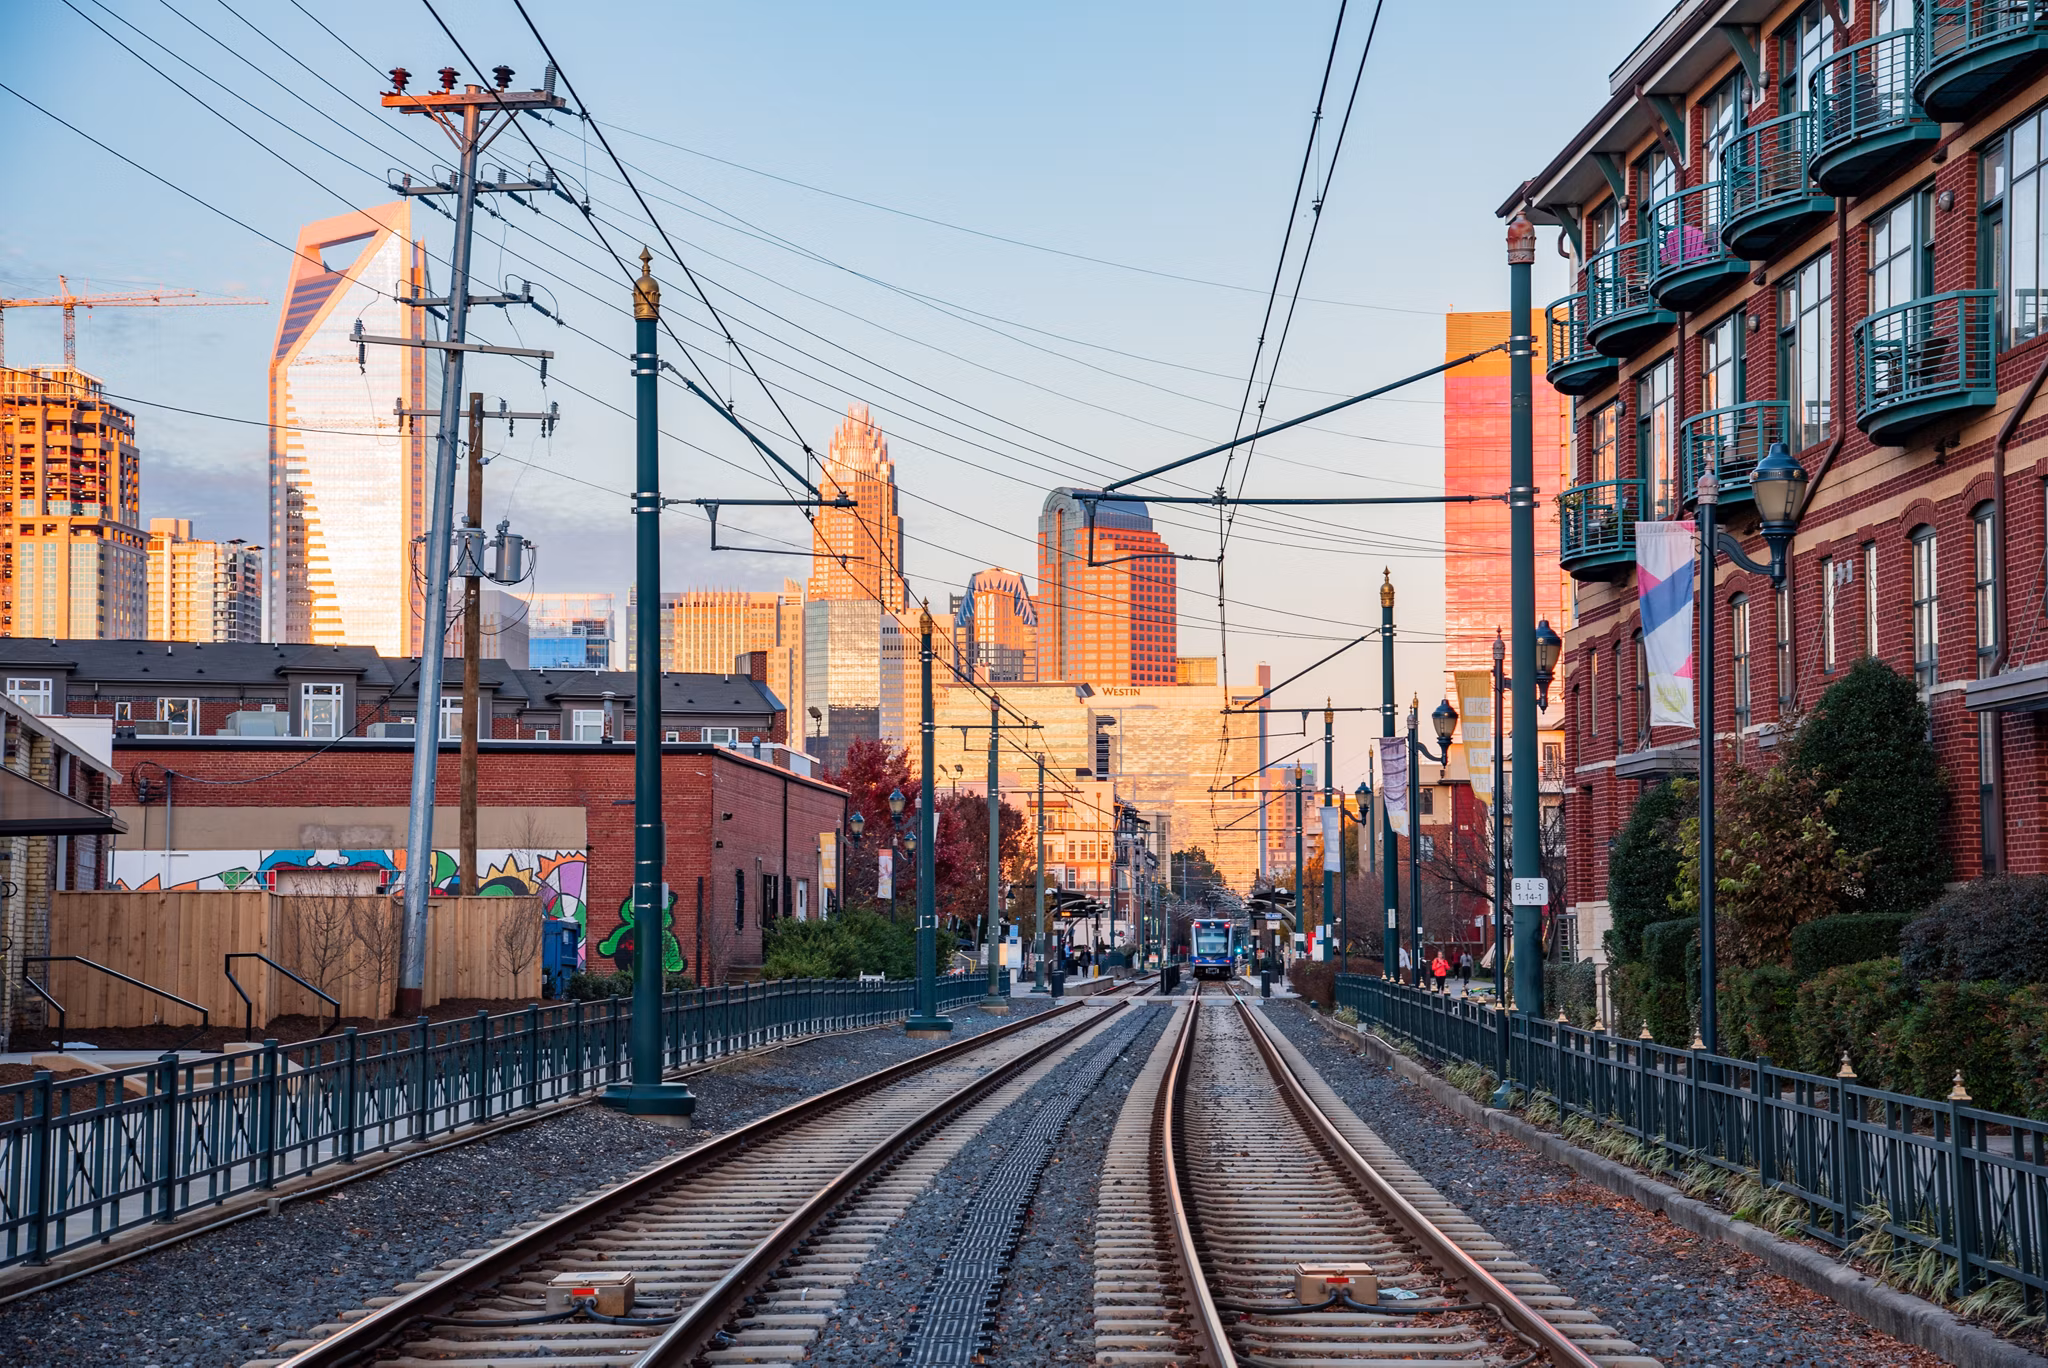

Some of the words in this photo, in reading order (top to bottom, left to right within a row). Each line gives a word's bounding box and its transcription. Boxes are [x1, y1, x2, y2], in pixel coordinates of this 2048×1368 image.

[1102, 687, 1140, 696] WESTIN
[1468, 701, 1489, 714] BIKE
[1465, 726, 1488, 738] YOUR
[1517, 893, 1542, 901] 1.14-1
